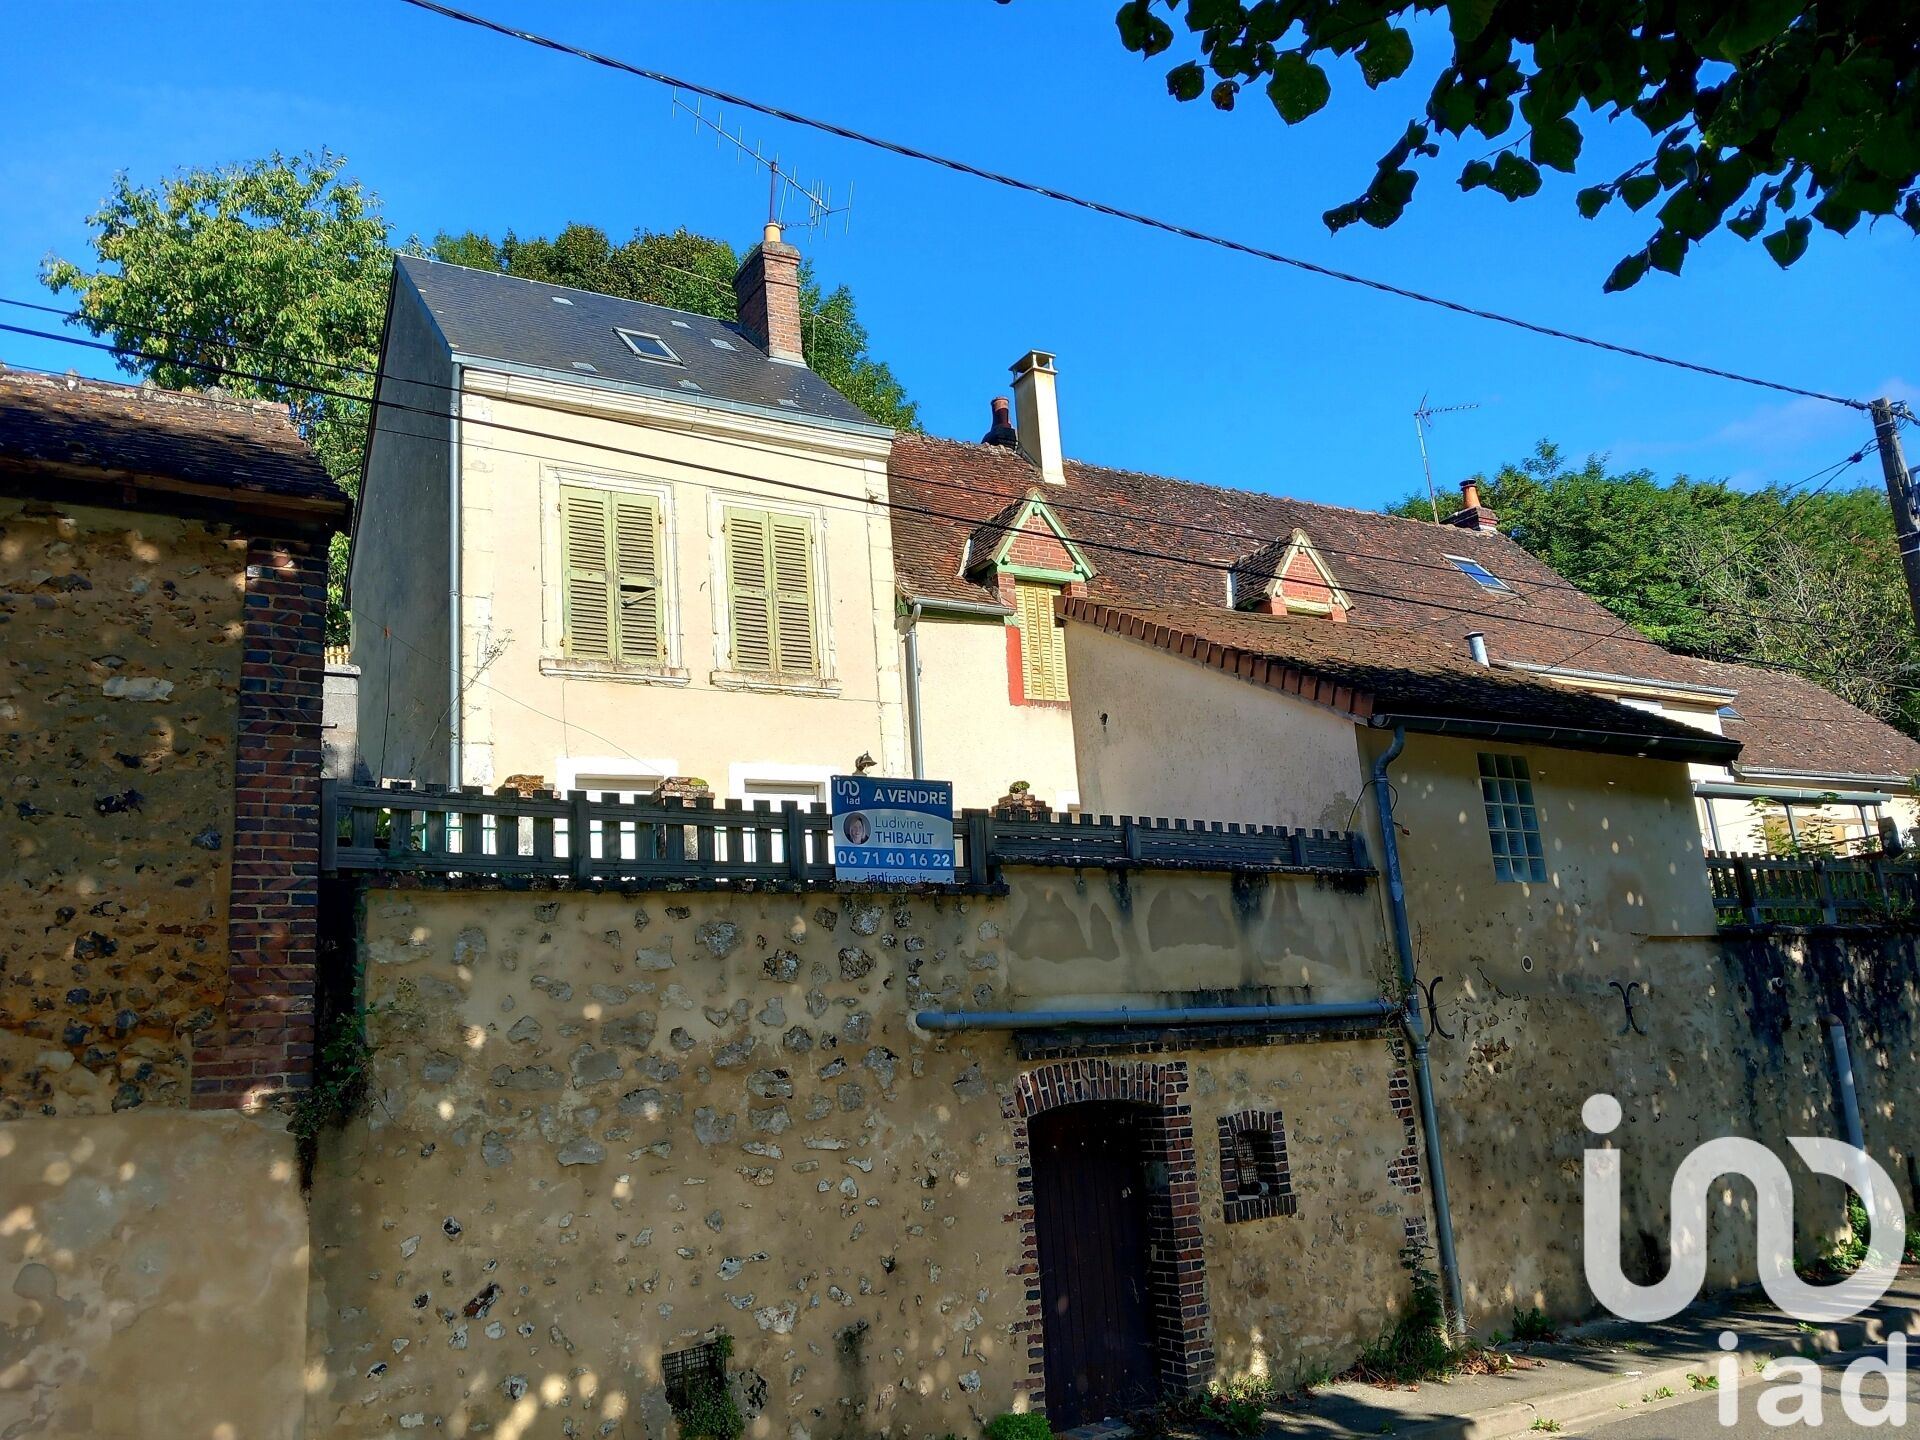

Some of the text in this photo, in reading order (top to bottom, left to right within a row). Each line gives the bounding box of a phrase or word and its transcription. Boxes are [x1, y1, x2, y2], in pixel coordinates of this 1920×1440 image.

[873, 788, 947, 805] A VENDRE
[875, 816, 924, 830] Ludivine
[875, 831, 934, 845] THIBAULT
[838, 850, 951, 867] 06 71 40 16 22
[867, 871, 927, 883] iadfrancefr
